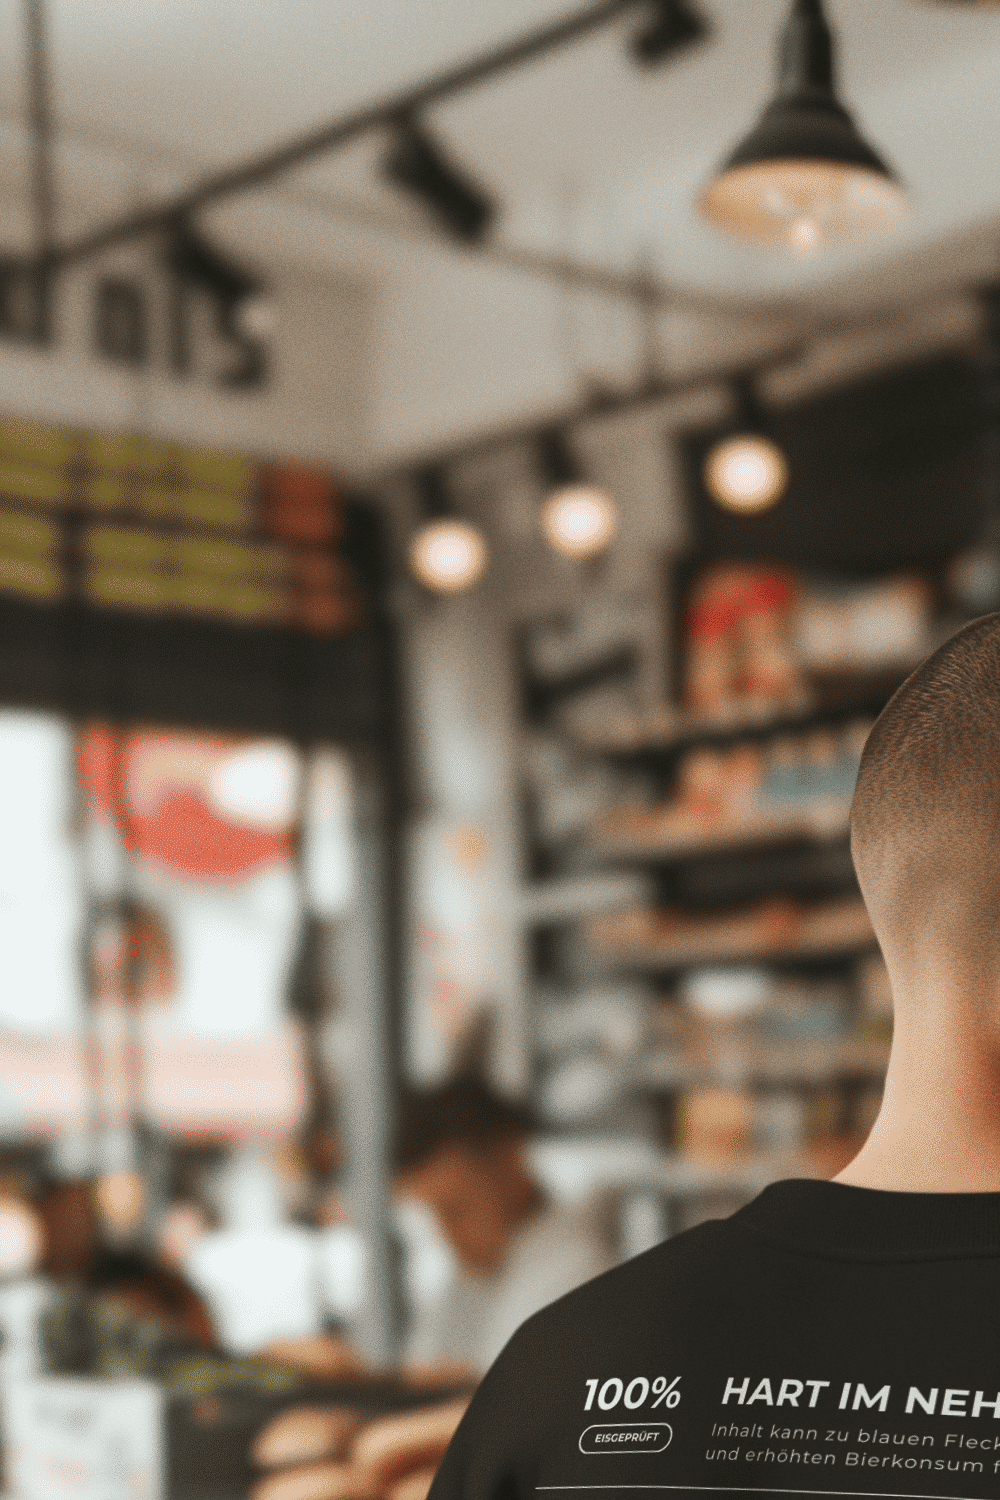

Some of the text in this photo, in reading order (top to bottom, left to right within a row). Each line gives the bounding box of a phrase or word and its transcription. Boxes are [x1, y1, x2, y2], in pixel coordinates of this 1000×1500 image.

[584, 1376, 681, 1411] 100%
[721, 1377, 830, 1408] HART
[838, 1382, 891, 1412] IM
[595, 1431, 660, 1443] EISGEPRÜFT
[712, 1423, 763, 1438] Inhalt
[770, 1425, 817, 1440] kann
[825, 1430, 848, 1441] zu
[858, 1429, 934, 1446] blauen
[706, 1447, 739, 1460] und
[746, 1448, 835, 1464] erhöhten
[845, 1452, 983, 1472] Bierkonsum
